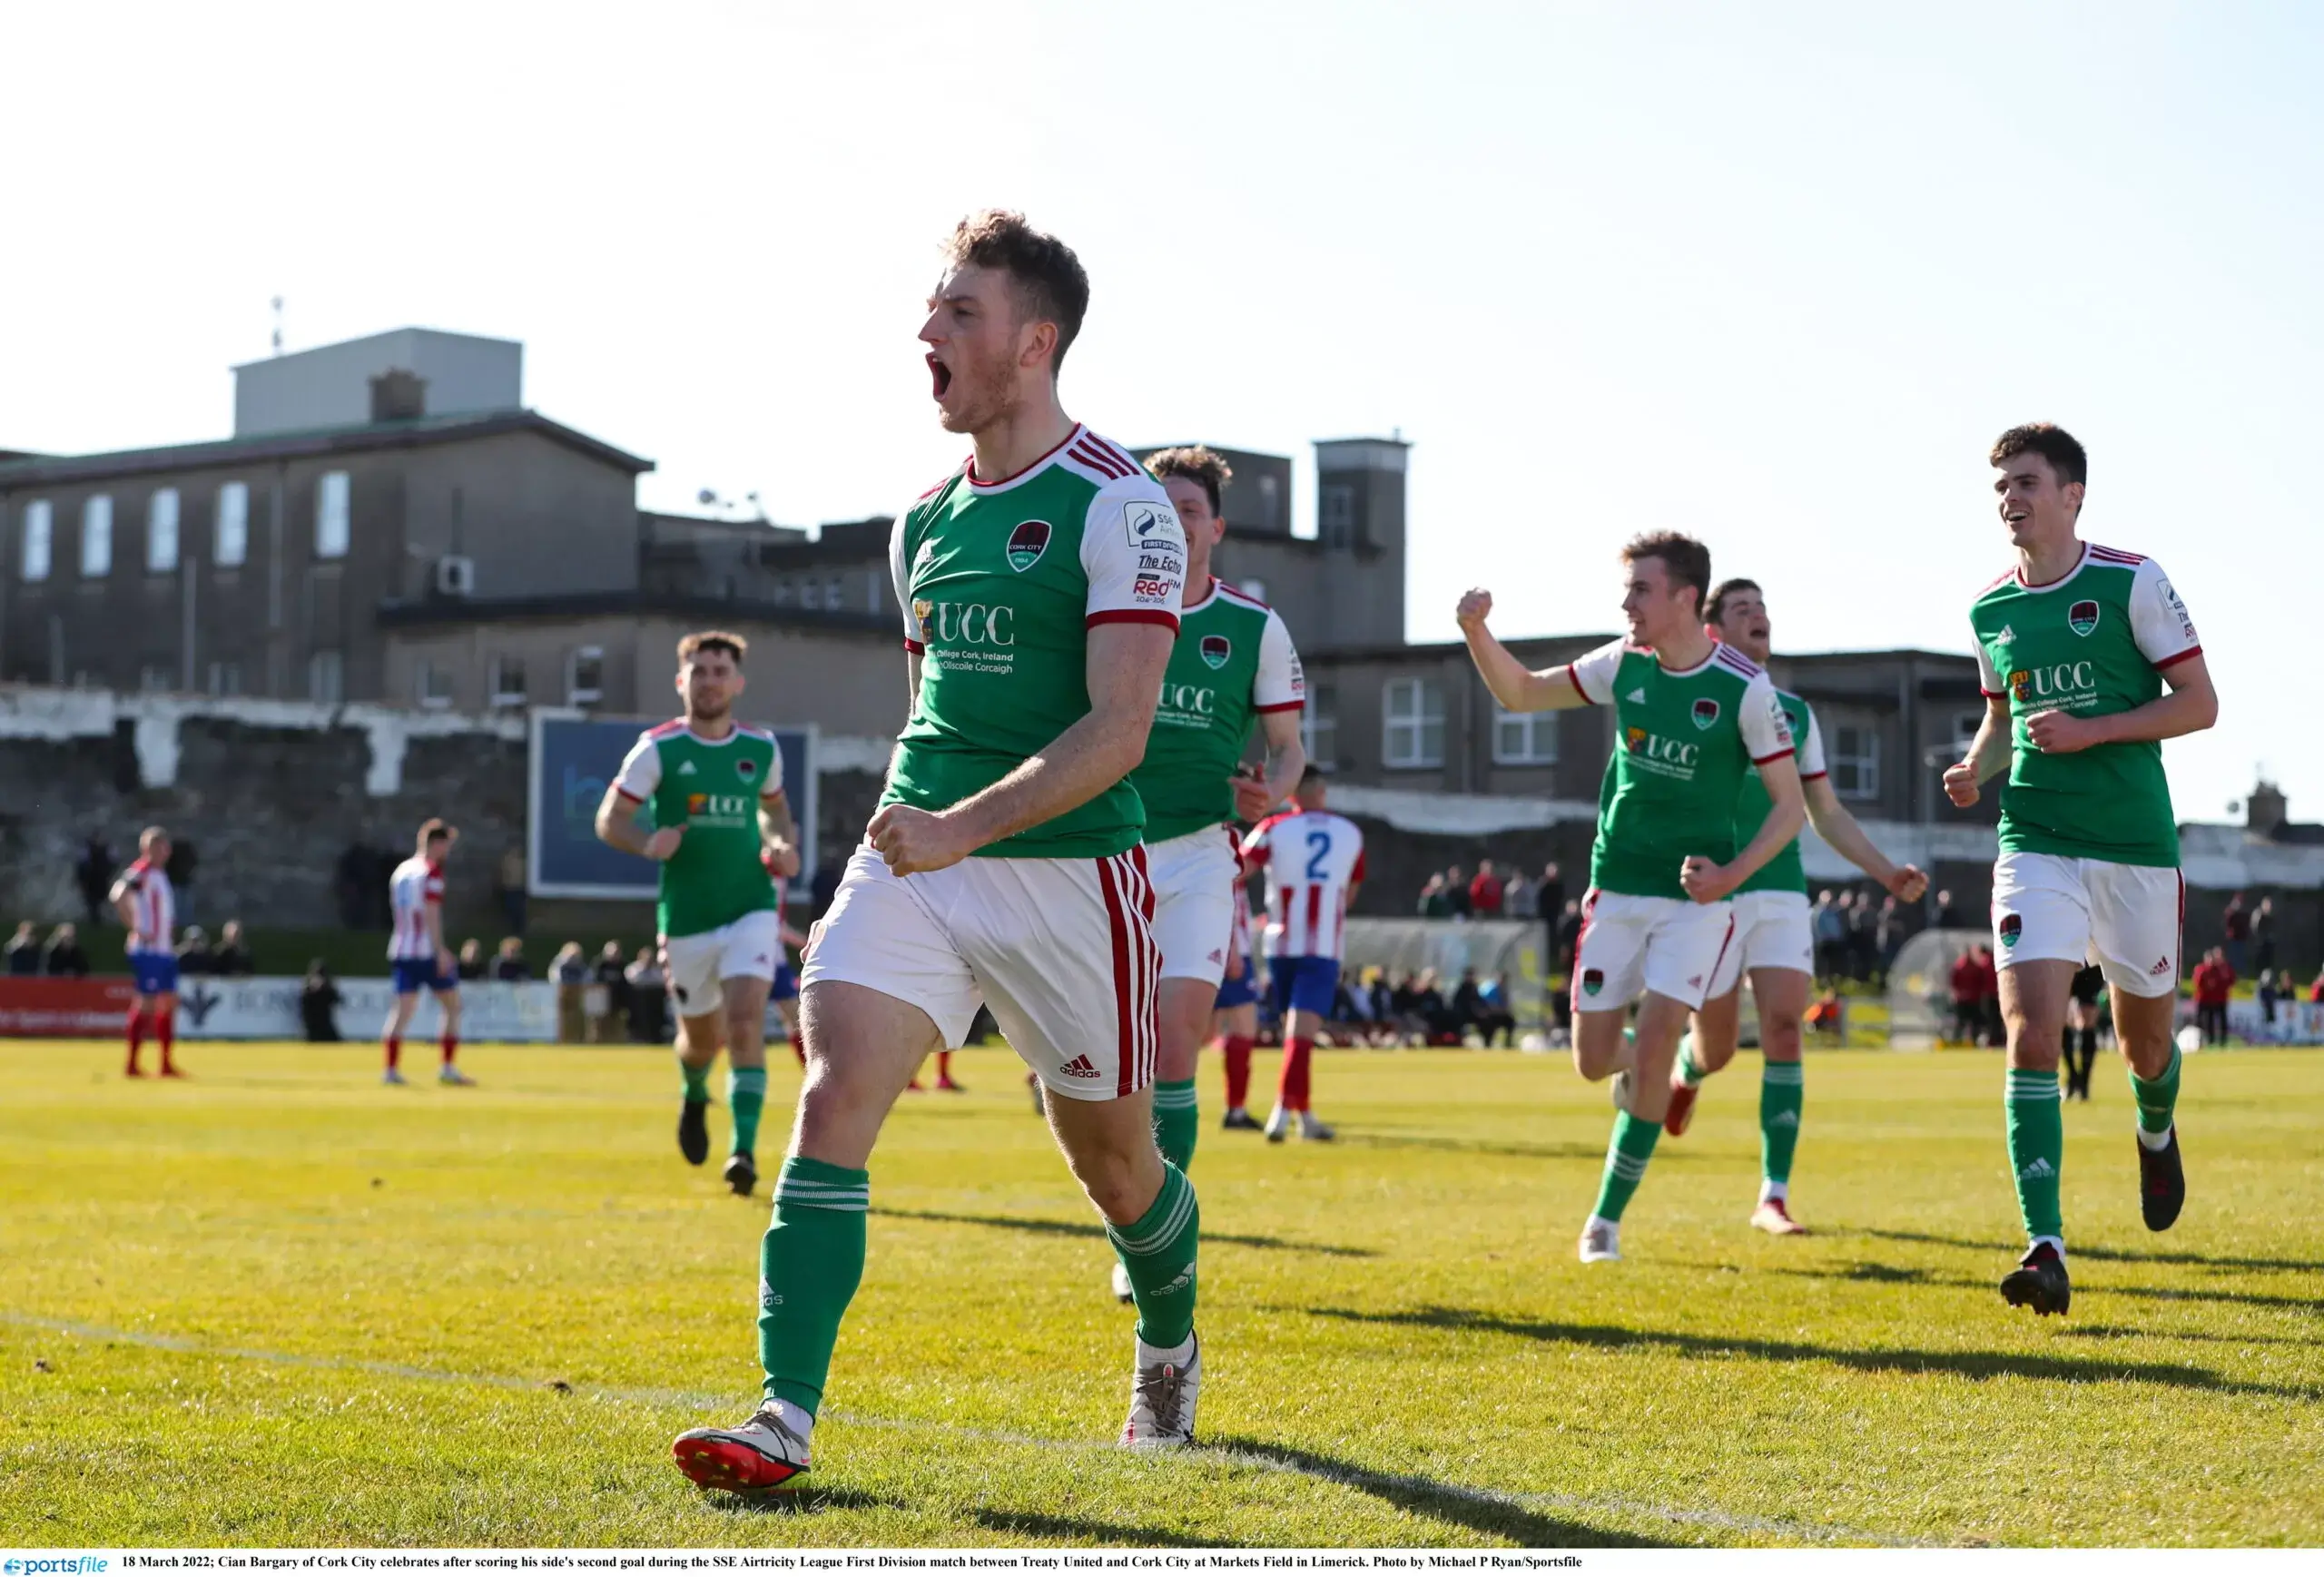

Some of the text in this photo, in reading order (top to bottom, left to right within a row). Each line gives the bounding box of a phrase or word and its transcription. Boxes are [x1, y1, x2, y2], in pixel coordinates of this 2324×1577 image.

[1138, 555, 1182, 574] The Echo
[1133, 578, 1170, 596] Red
[938, 602, 1015, 646] UCC
[961, 650, 981, 660] Cork,
[982, 652, 1014, 662] Ireland
[975, 662, 1013, 675] Corcaigh
[2033, 661, 2096, 695] UCC
[1157, 682, 1215, 714] UCC
[1647, 734, 1699, 766] UCC
[1305, 831, 1332, 880] 2
[1059, 1066, 1101, 1079] adidas
